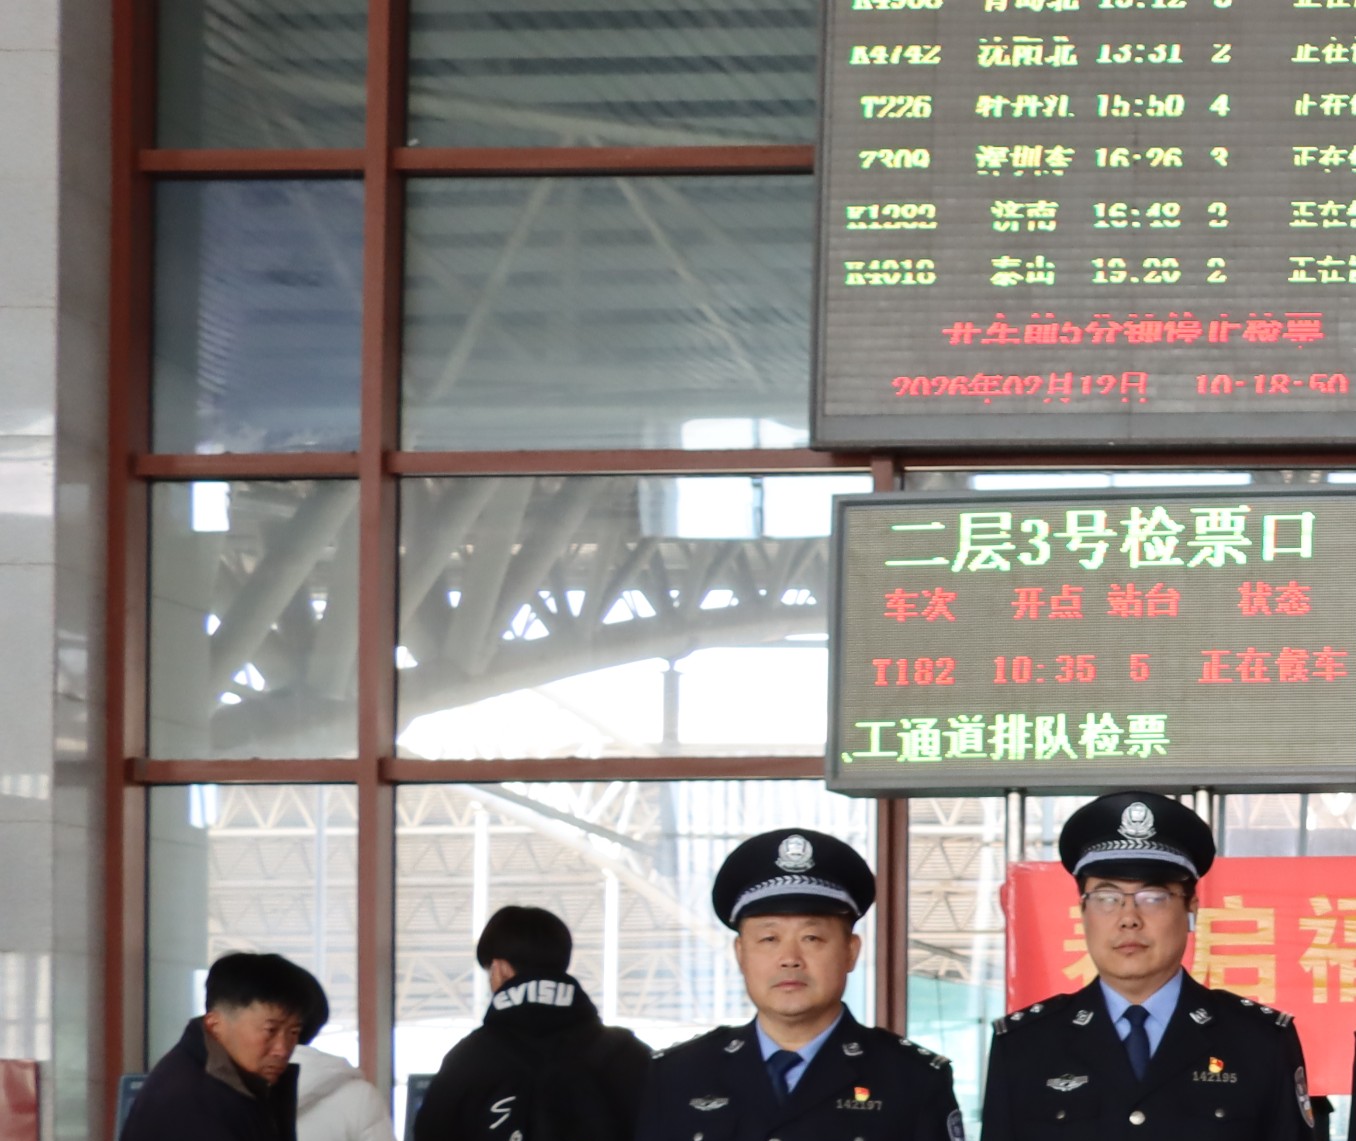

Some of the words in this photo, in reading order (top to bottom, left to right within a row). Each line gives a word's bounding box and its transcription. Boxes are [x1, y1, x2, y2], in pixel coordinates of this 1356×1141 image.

[1208, 93, 1231, 117] 4
[884, 504, 1316, 573] 二层3号检票口
[884, 587, 958, 623] 车次
[1011, 584, 1084, 620] 开点
[1107, 582, 1181, 619] 站台
[1238, 580, 1312, 617] 状态
[872, 657, 956, 687] T182
[993, 654, 1097, 685] 10:35
[1129, 654, 1151, 682] 5
[1199, 646, 1348, 684] 正在候车
[493, 980, 575, 1011] EVISU
[1192, 1071, 1237, 1083] 142195
[836, 1099, 882, 1111] 142197
